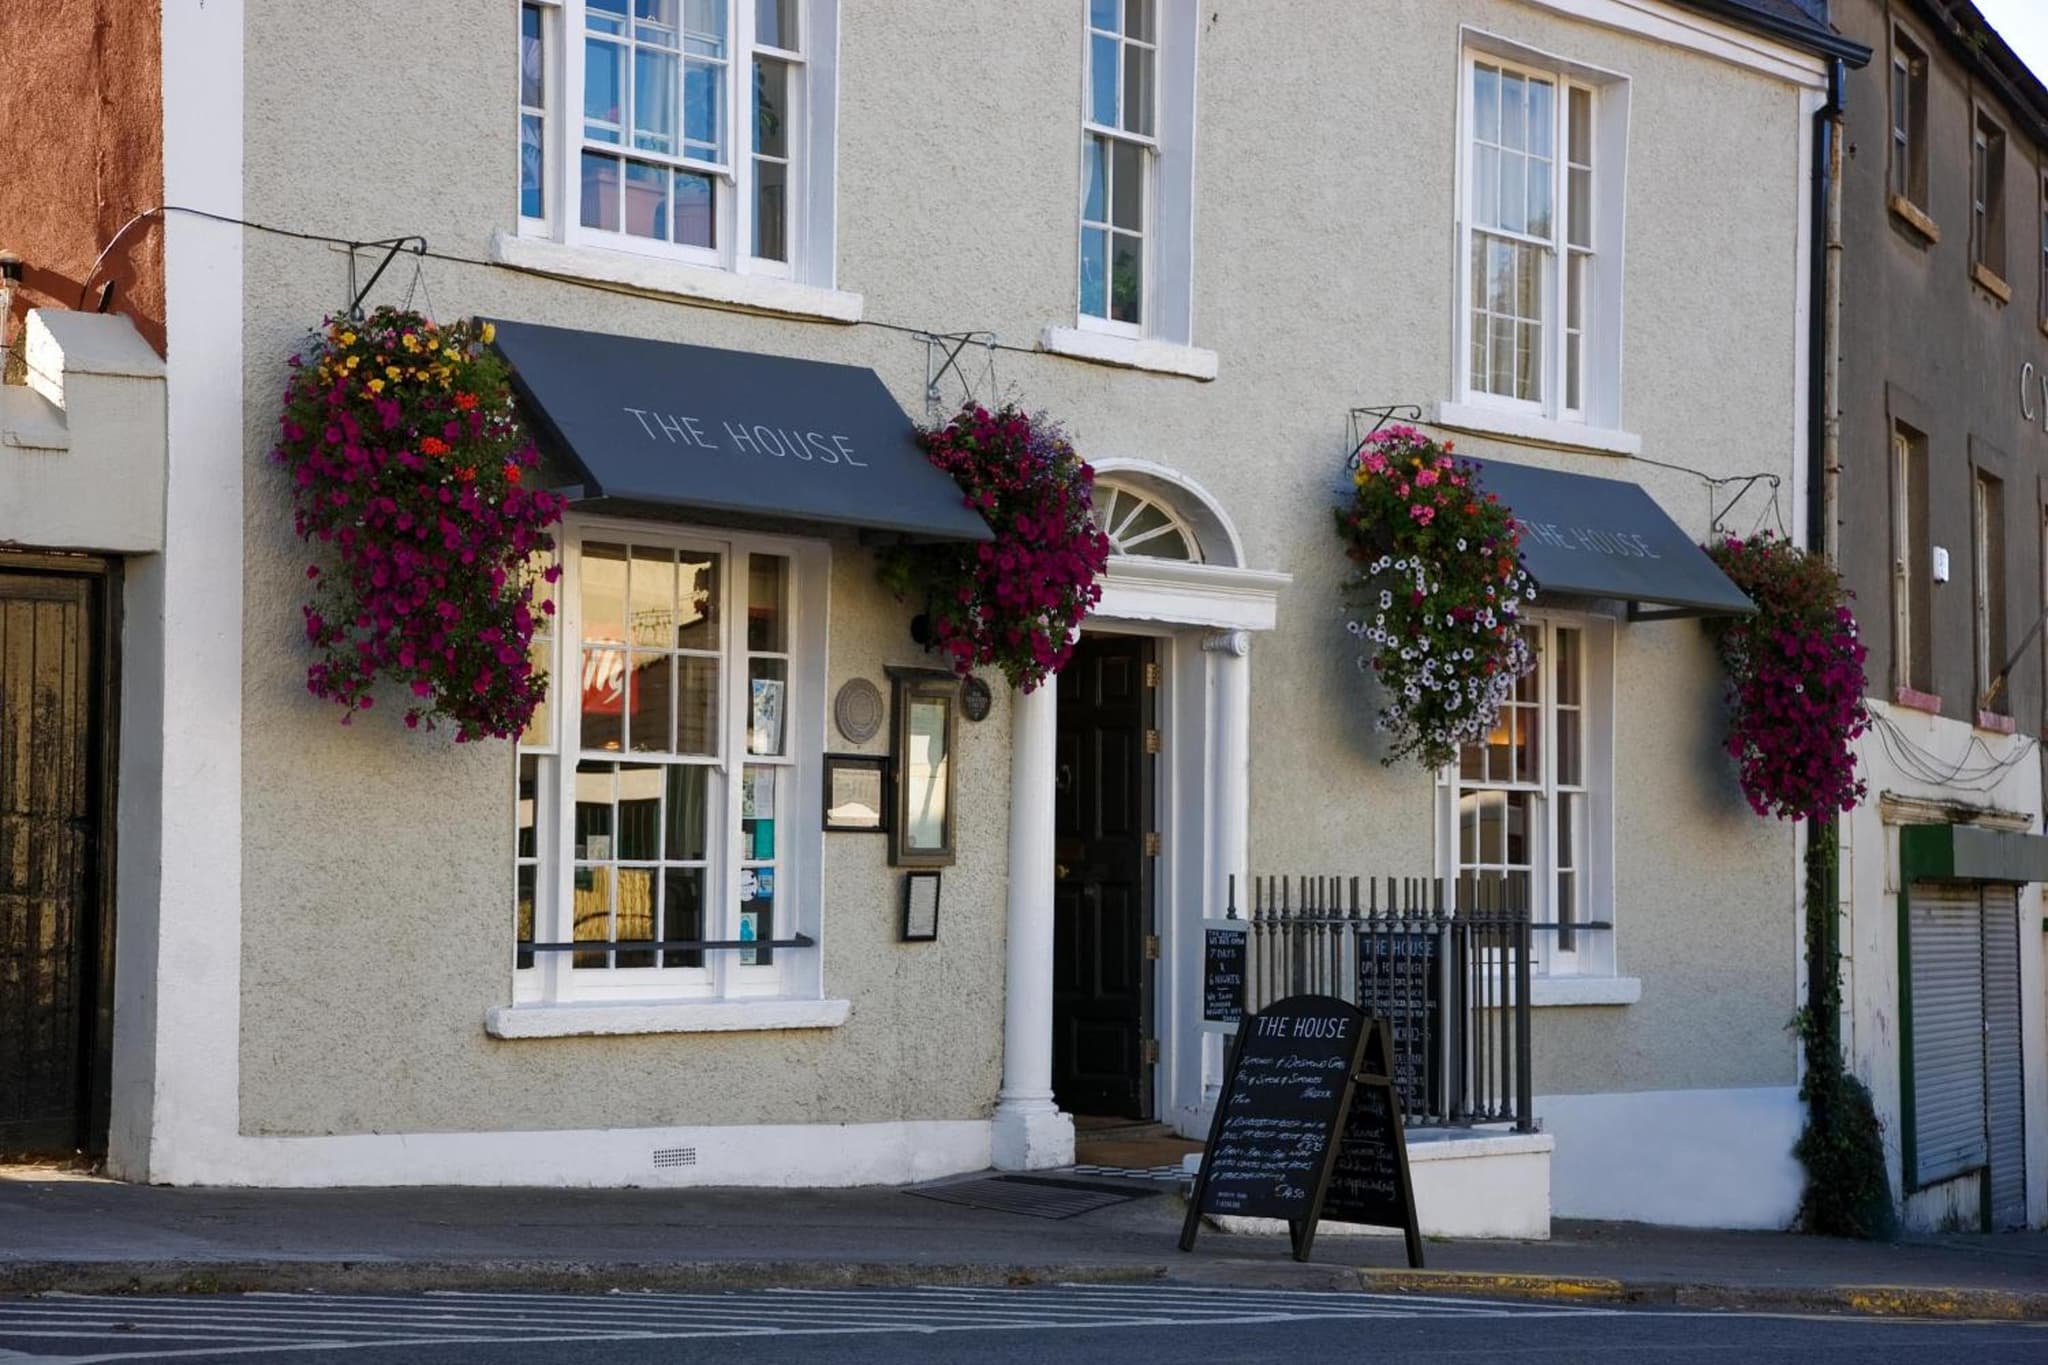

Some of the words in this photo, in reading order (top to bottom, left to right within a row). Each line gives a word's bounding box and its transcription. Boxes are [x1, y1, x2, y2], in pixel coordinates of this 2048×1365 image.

[624, 407, 718, 449] THE
[723, 421, 868, 467] HOUSE
[1515, 518, 1576, 550] THE
[1570, 528, 1661, 560] HOUSE
[1257, 1016, 1289, 1037] THE
[1293, 1017, 1348, 1039] HOUSE
